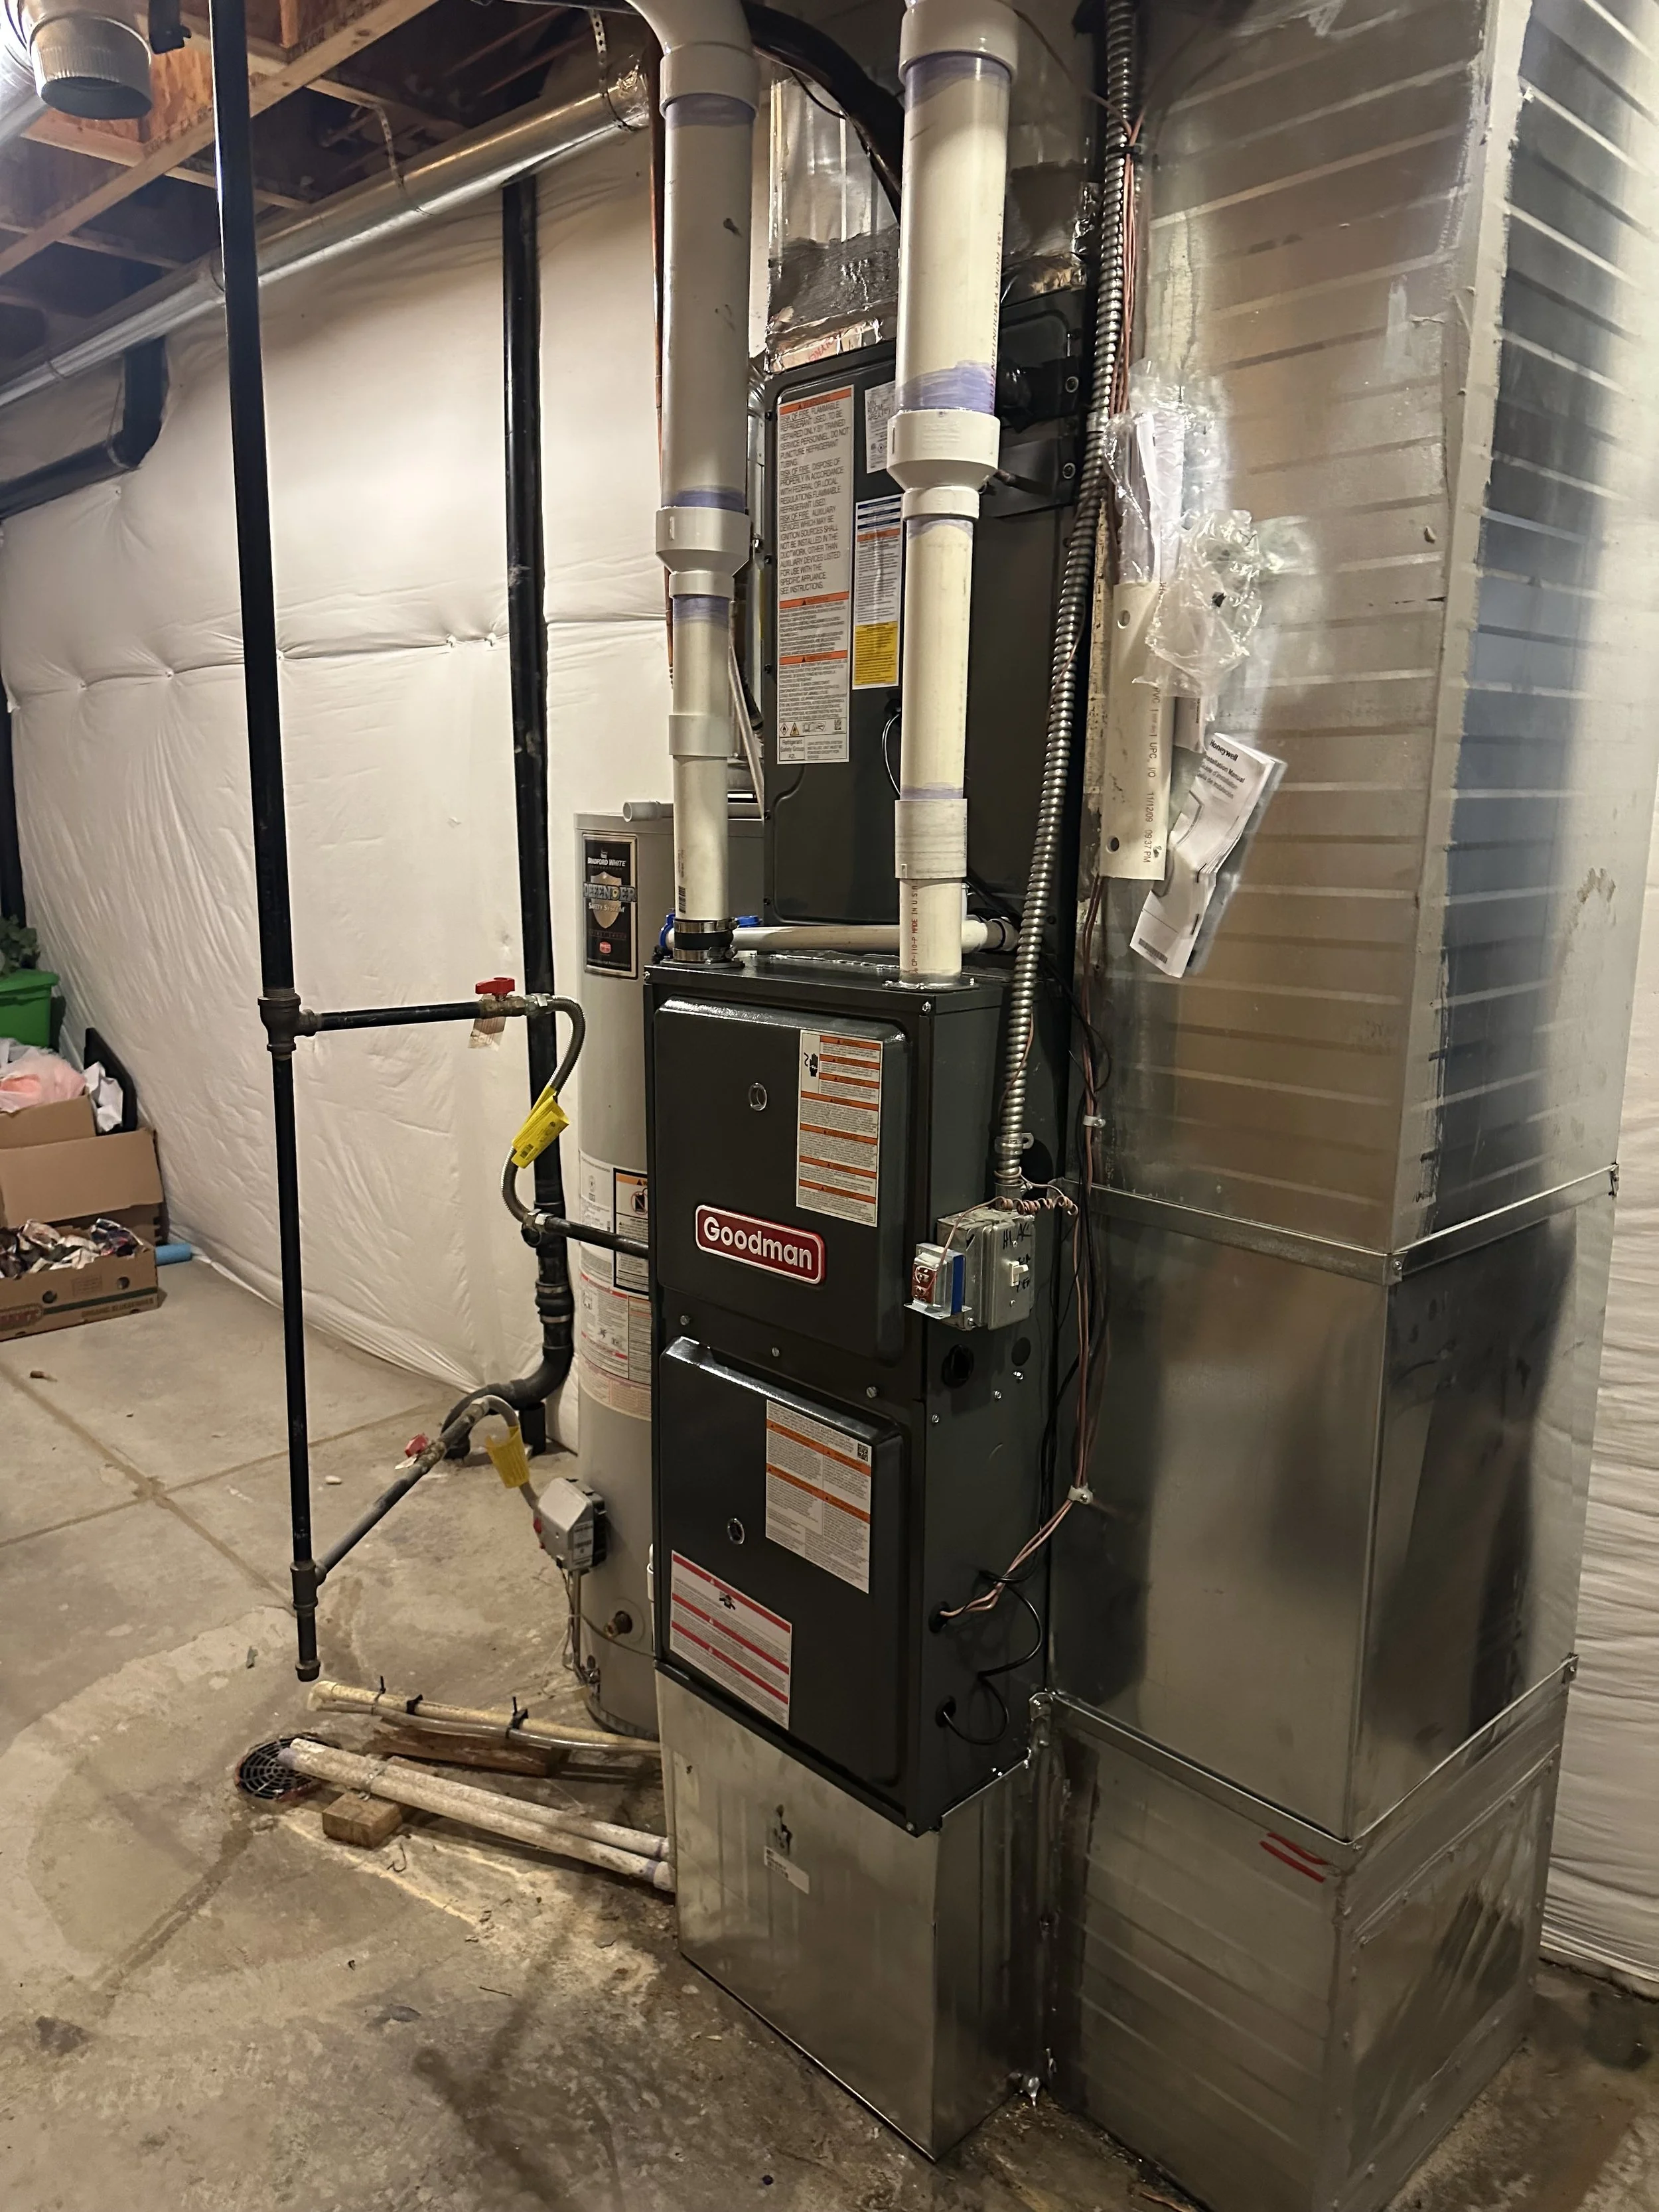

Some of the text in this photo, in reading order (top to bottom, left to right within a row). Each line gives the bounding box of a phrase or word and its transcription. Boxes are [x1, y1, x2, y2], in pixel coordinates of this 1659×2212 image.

[1210, 739, 1238, 761] Honeywell
[1228, 769, 1245, 783] Manual
[1145, 792, 1155, 822] 11/12/09
[1144, 830, 1153, 849] 09:37
[1142, 851, 1151, 863] PM
[584, 883, 636, 901] DEFENDER
[703, 1217, 812, 1270] Goodman
